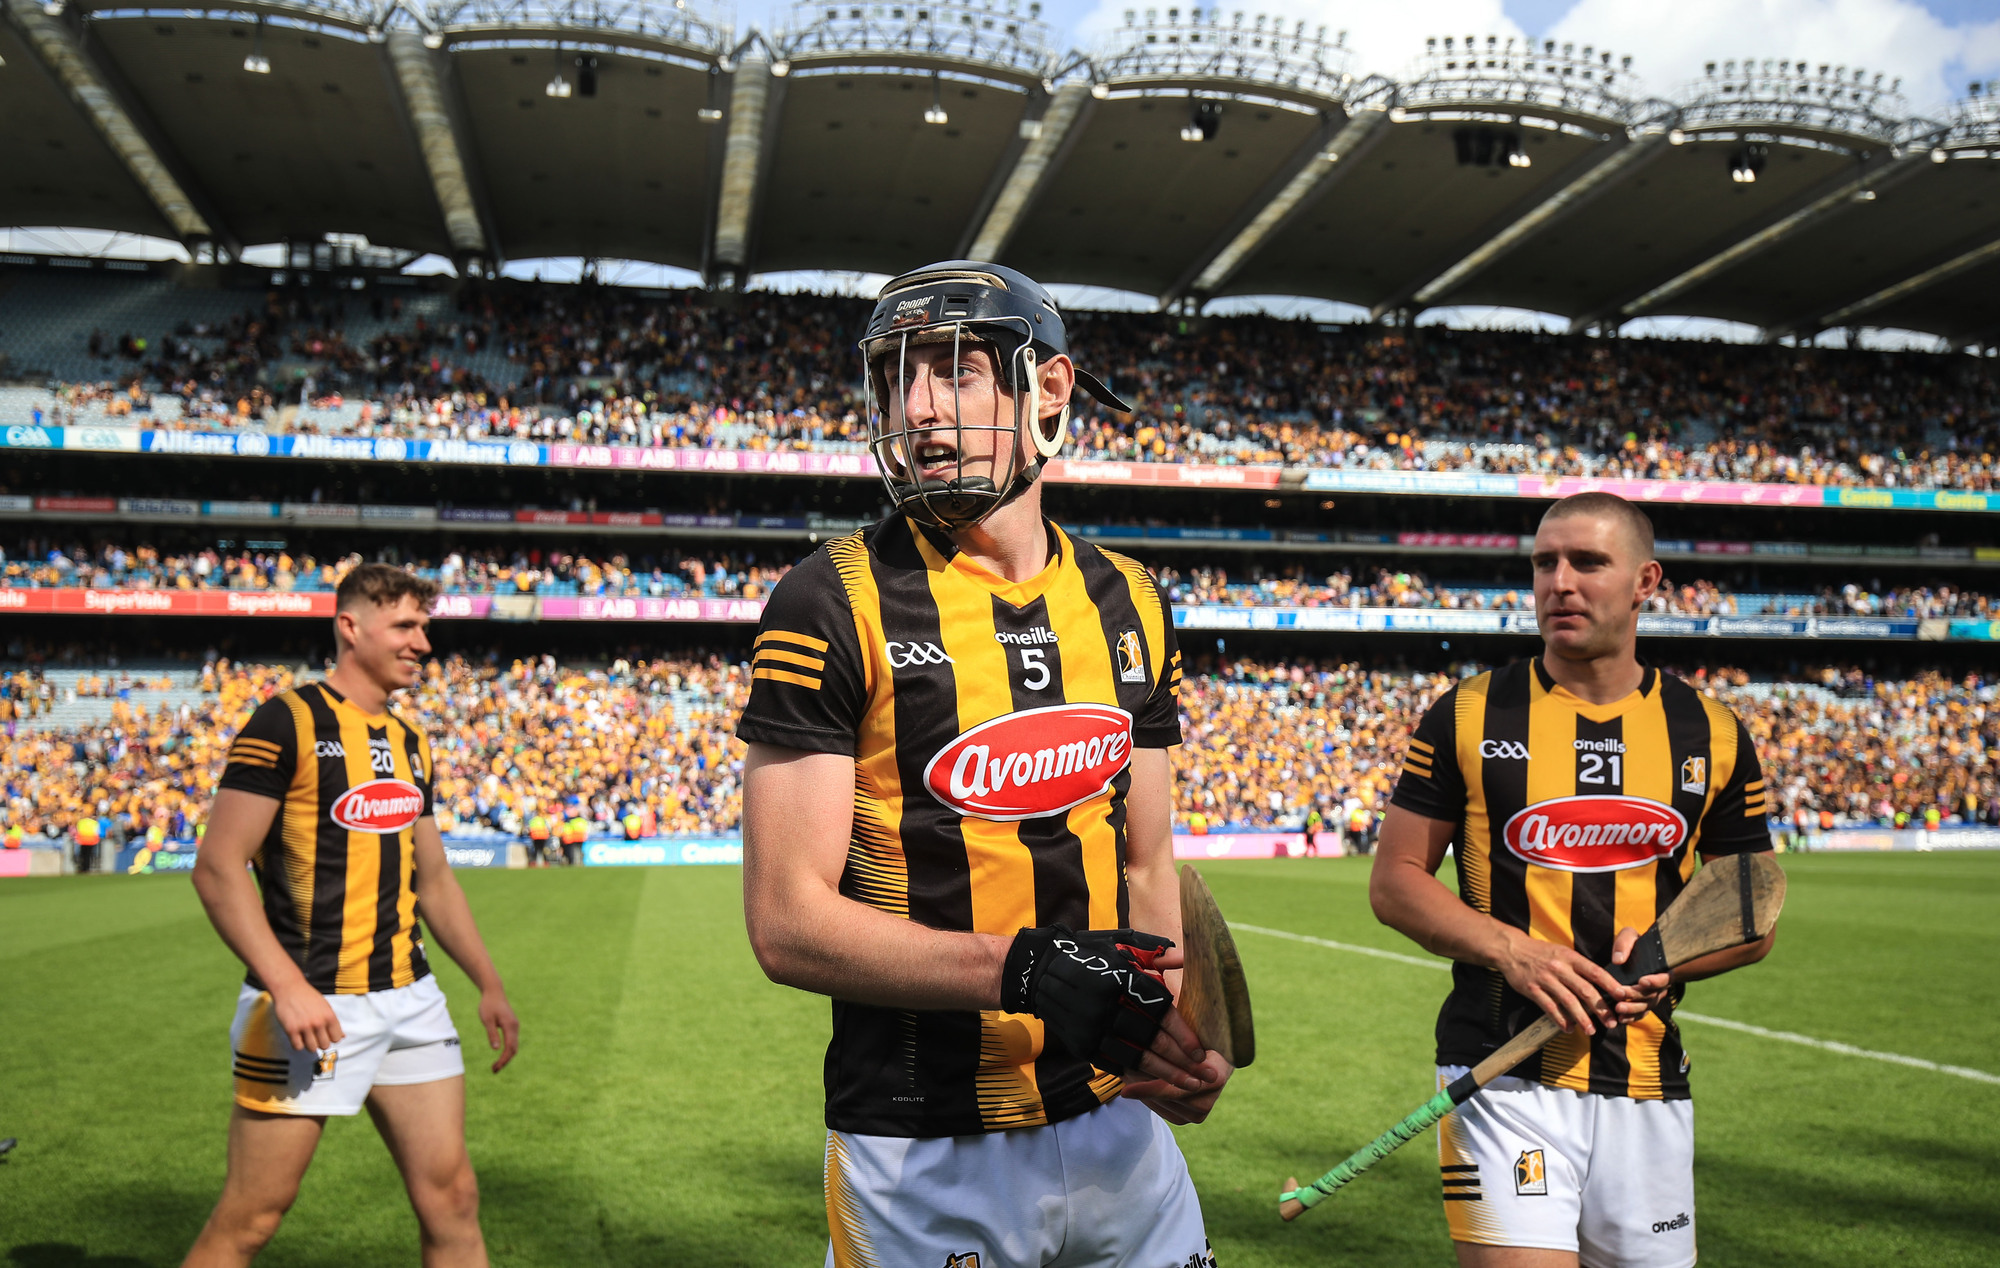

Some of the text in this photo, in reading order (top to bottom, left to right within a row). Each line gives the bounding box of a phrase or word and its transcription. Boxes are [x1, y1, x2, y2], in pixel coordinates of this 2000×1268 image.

[896, 295, 934, 311] Cooper
[150, 430, 235, 455] Allianz
[291, 435, 374, 459] Allianz
[427, 440, 507, 464] Allianz
[576, 446, 612, 466] AIB
[641, 449, 676, 469] AIB
[704, 451, 739, 470] AIB
[766, 453, 800, 472] AIB
[827, 455, 862, 474] AIB
[84, 590, 172, 613] SuperValu
[228, 592, 312, 615] SuperValu
[433, 596, 472, 617] AIB
[601, 599, 637, 618] AIB
[665, 599, 700, 619] AIB
[728, 600, 762, 620] AIB
[994, 627, 1059, 645] o'neills
[885, 642, 956, 668] GAA
[1020, 648, 1051, 690] 5
[315, 741, 347, 757] GAA
[1478, 739, 1532, 760] GAA
[1572, 738, 1627, 753] o'neills
[370, 749, 395, 773] 20
[1579, 753, 1621, 786] 21
